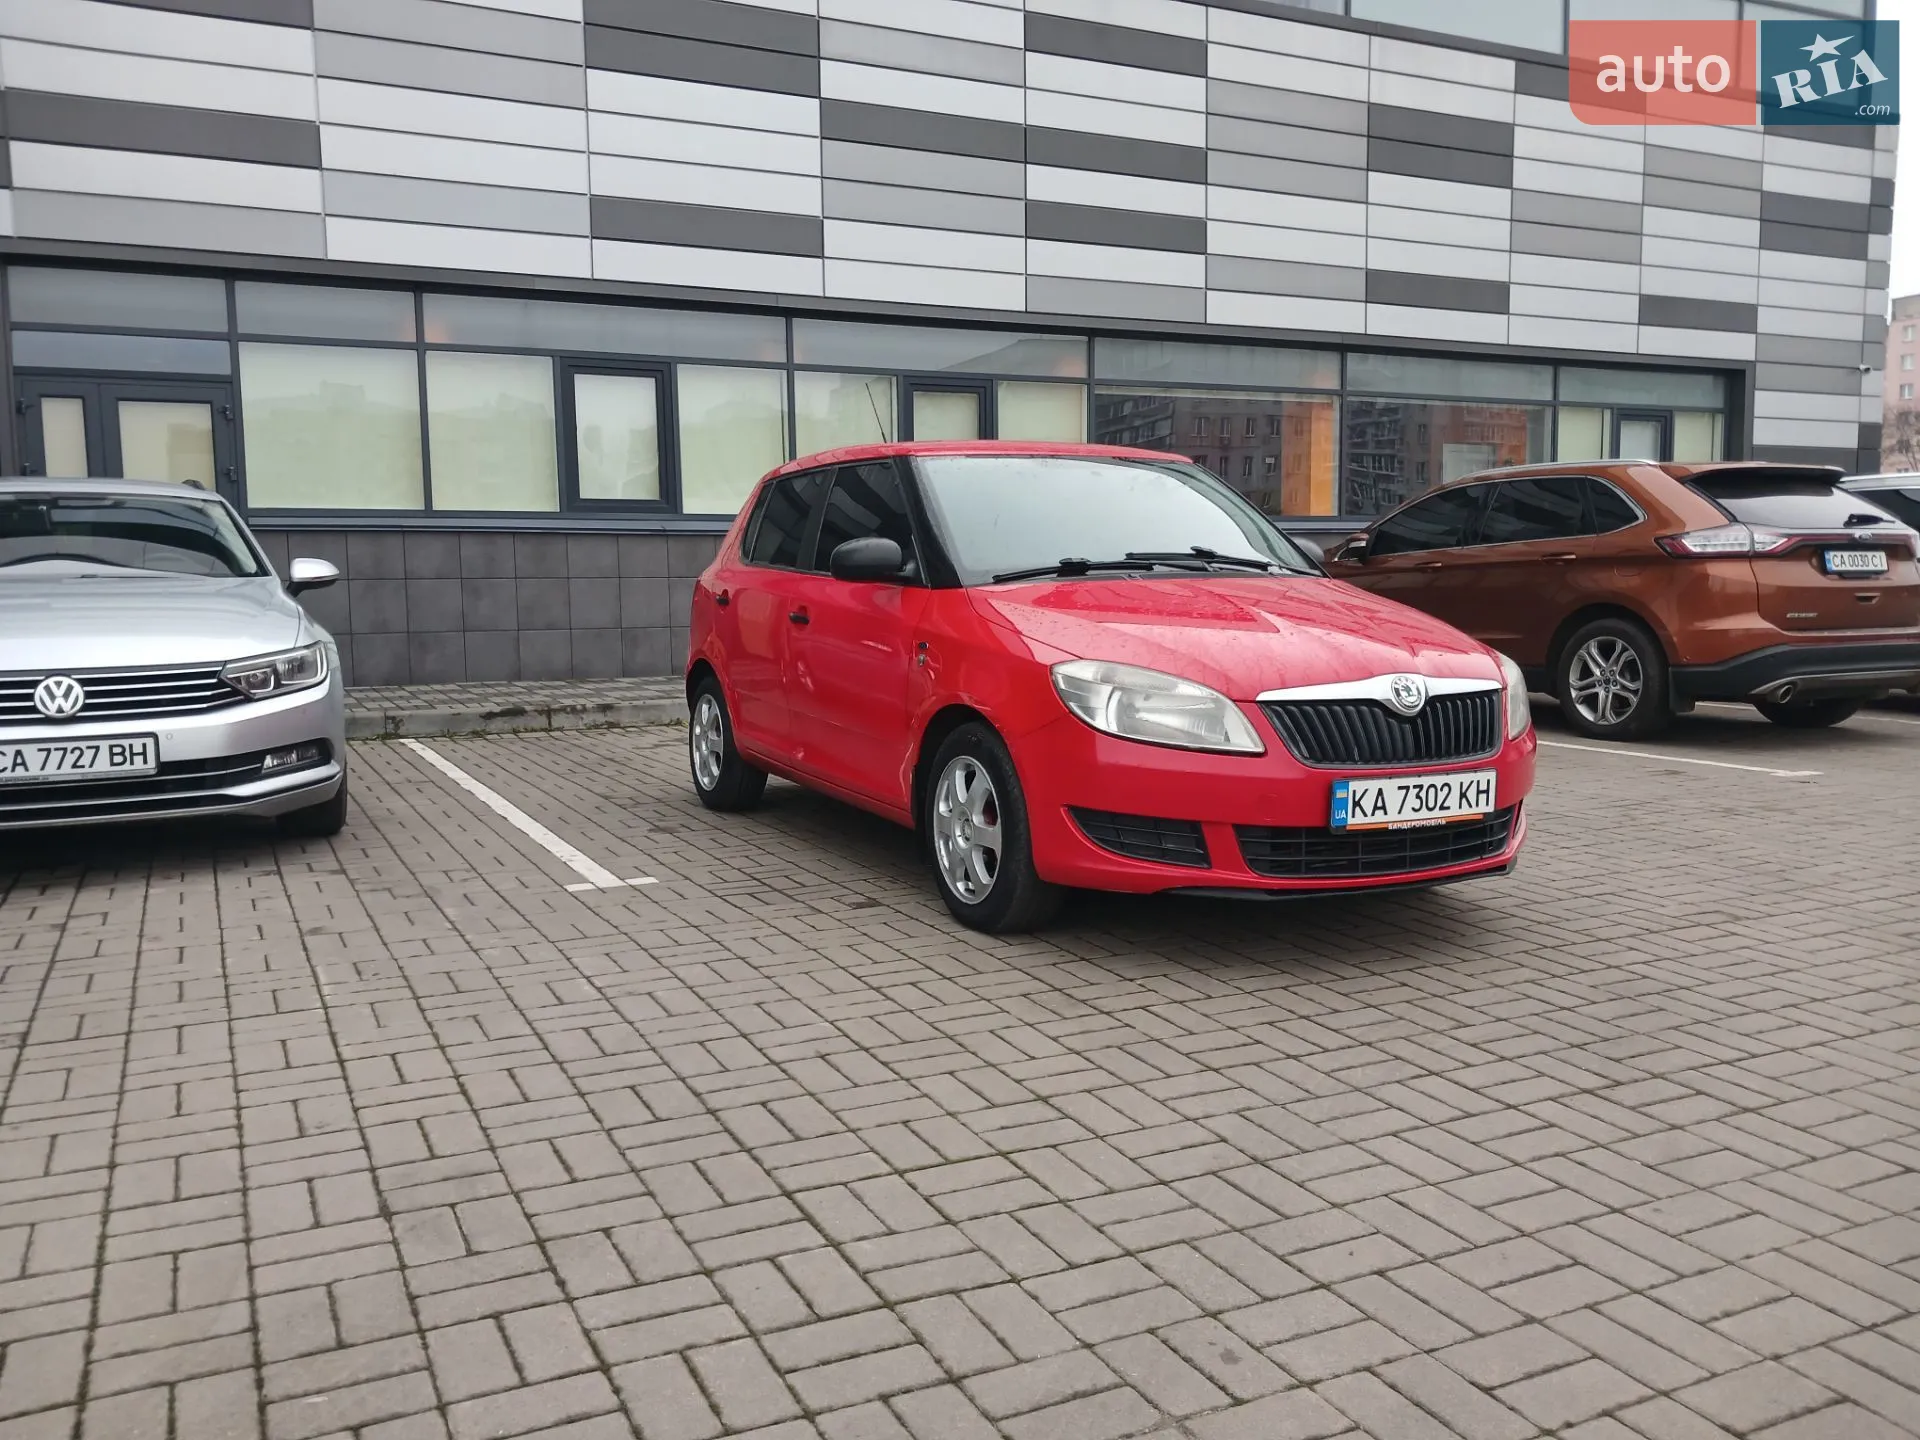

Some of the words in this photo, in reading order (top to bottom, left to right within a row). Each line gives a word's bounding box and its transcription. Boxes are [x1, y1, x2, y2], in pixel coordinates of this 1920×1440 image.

[1832, 554, 1848, 568] CA
[1849, 554, 1870, 567] 0030
[37, 745, 101, 771] 7727
[108, 742, 149, 767] BH
[1351, 787, 1388, 819] KA
[1397, 782, 1453, 815] 7302
[1458, 778, 1491, 810] KH
[1335, 809, 1347, 820] UA
